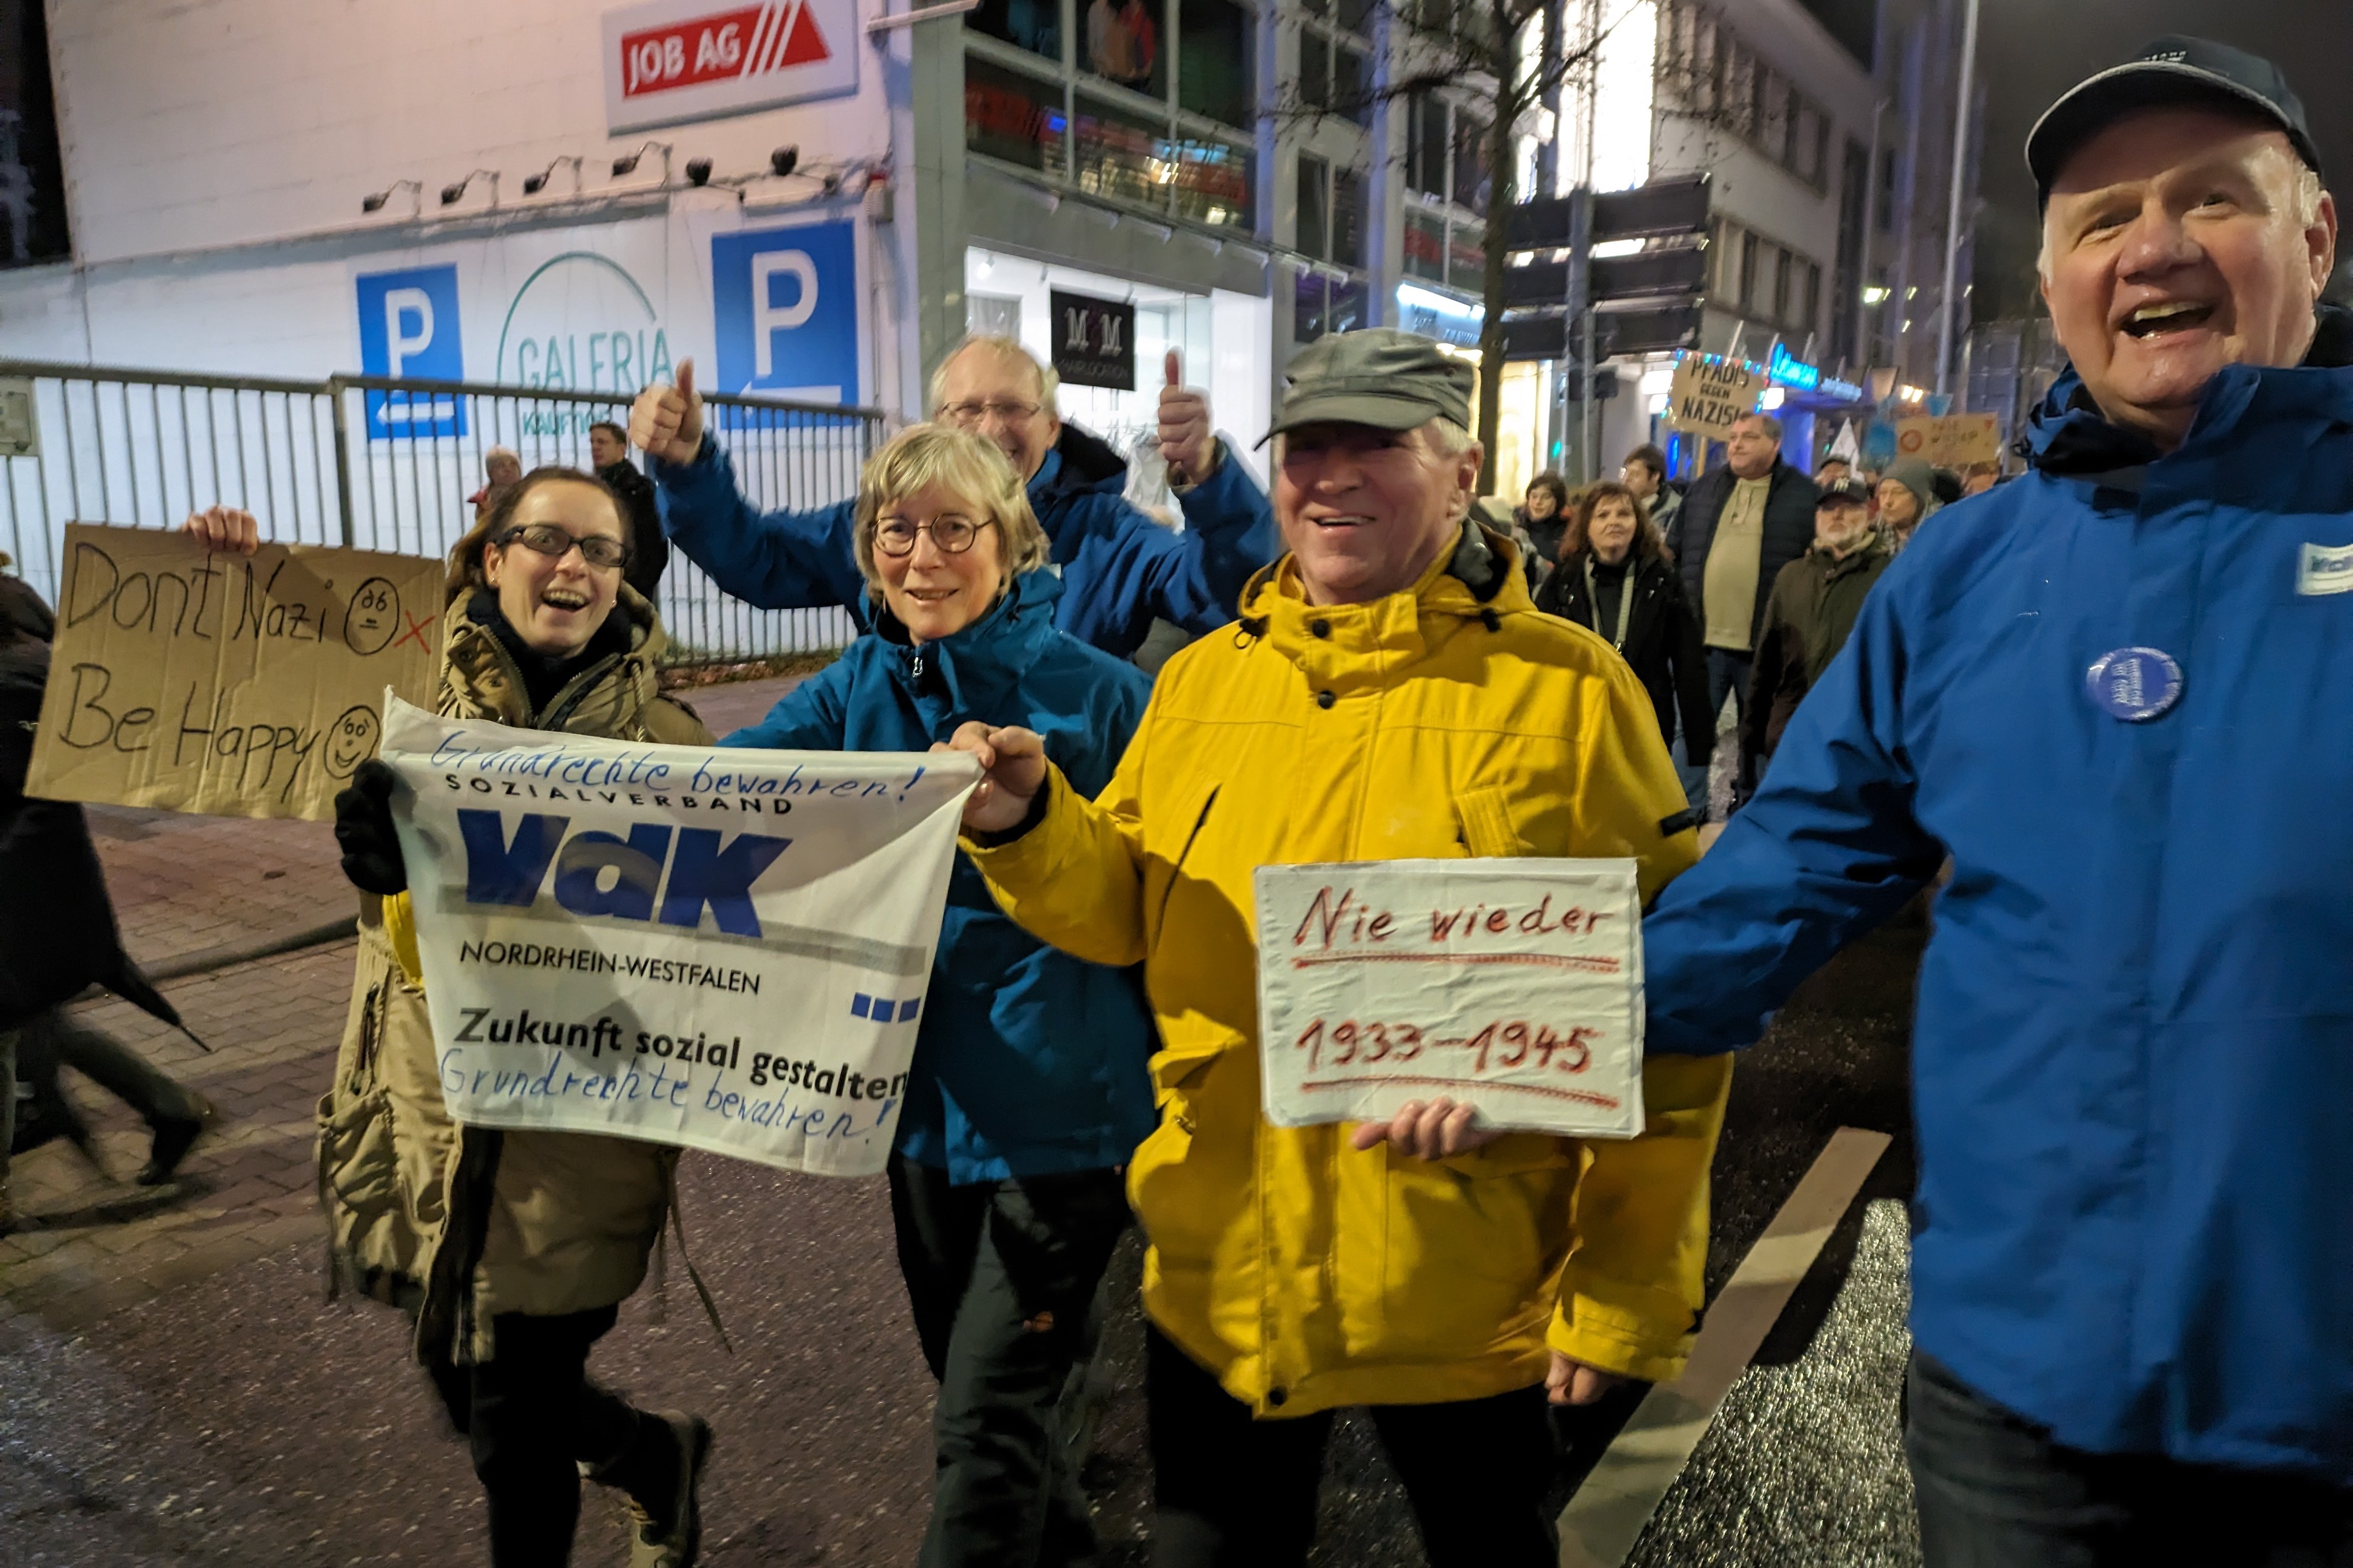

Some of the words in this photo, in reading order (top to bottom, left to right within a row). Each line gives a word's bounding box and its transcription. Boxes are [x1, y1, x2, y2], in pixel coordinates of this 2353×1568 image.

[627, 35, 685, 96] JOB
[693, 22, 740, 76] AG
[385, 287, 435, 381] P
[751, 248, 819, 380] P
[1690, 355, 1750, 389] PFADIS
[1700, 383, 1730, 399] GEGEN
[232, 559, 334, 644] Nazi
[59, 662, 155, 752] Be
[173, 681, 322, 803] Happy
[431, 731, 670, 791] Grundrechte
[691, 756, 926, 803] bewahren!
[445, 772, 793, 815] SOZIALVERBAND
[456, 808, 794, 938] VdK
[1293, 885, 1399, 950] Nie
[1429, 892, 1614, 944] wieder
[459, 940, 761, 996] NORDRHEIN-WESTFALEN
[454, 1007, 623, 1057] Zukunft
[636, 1031, 741, 1070] sozial
[749, 1051, 909, 1100] gestalten
[704, 1067, 898, 1146] bewahren!
